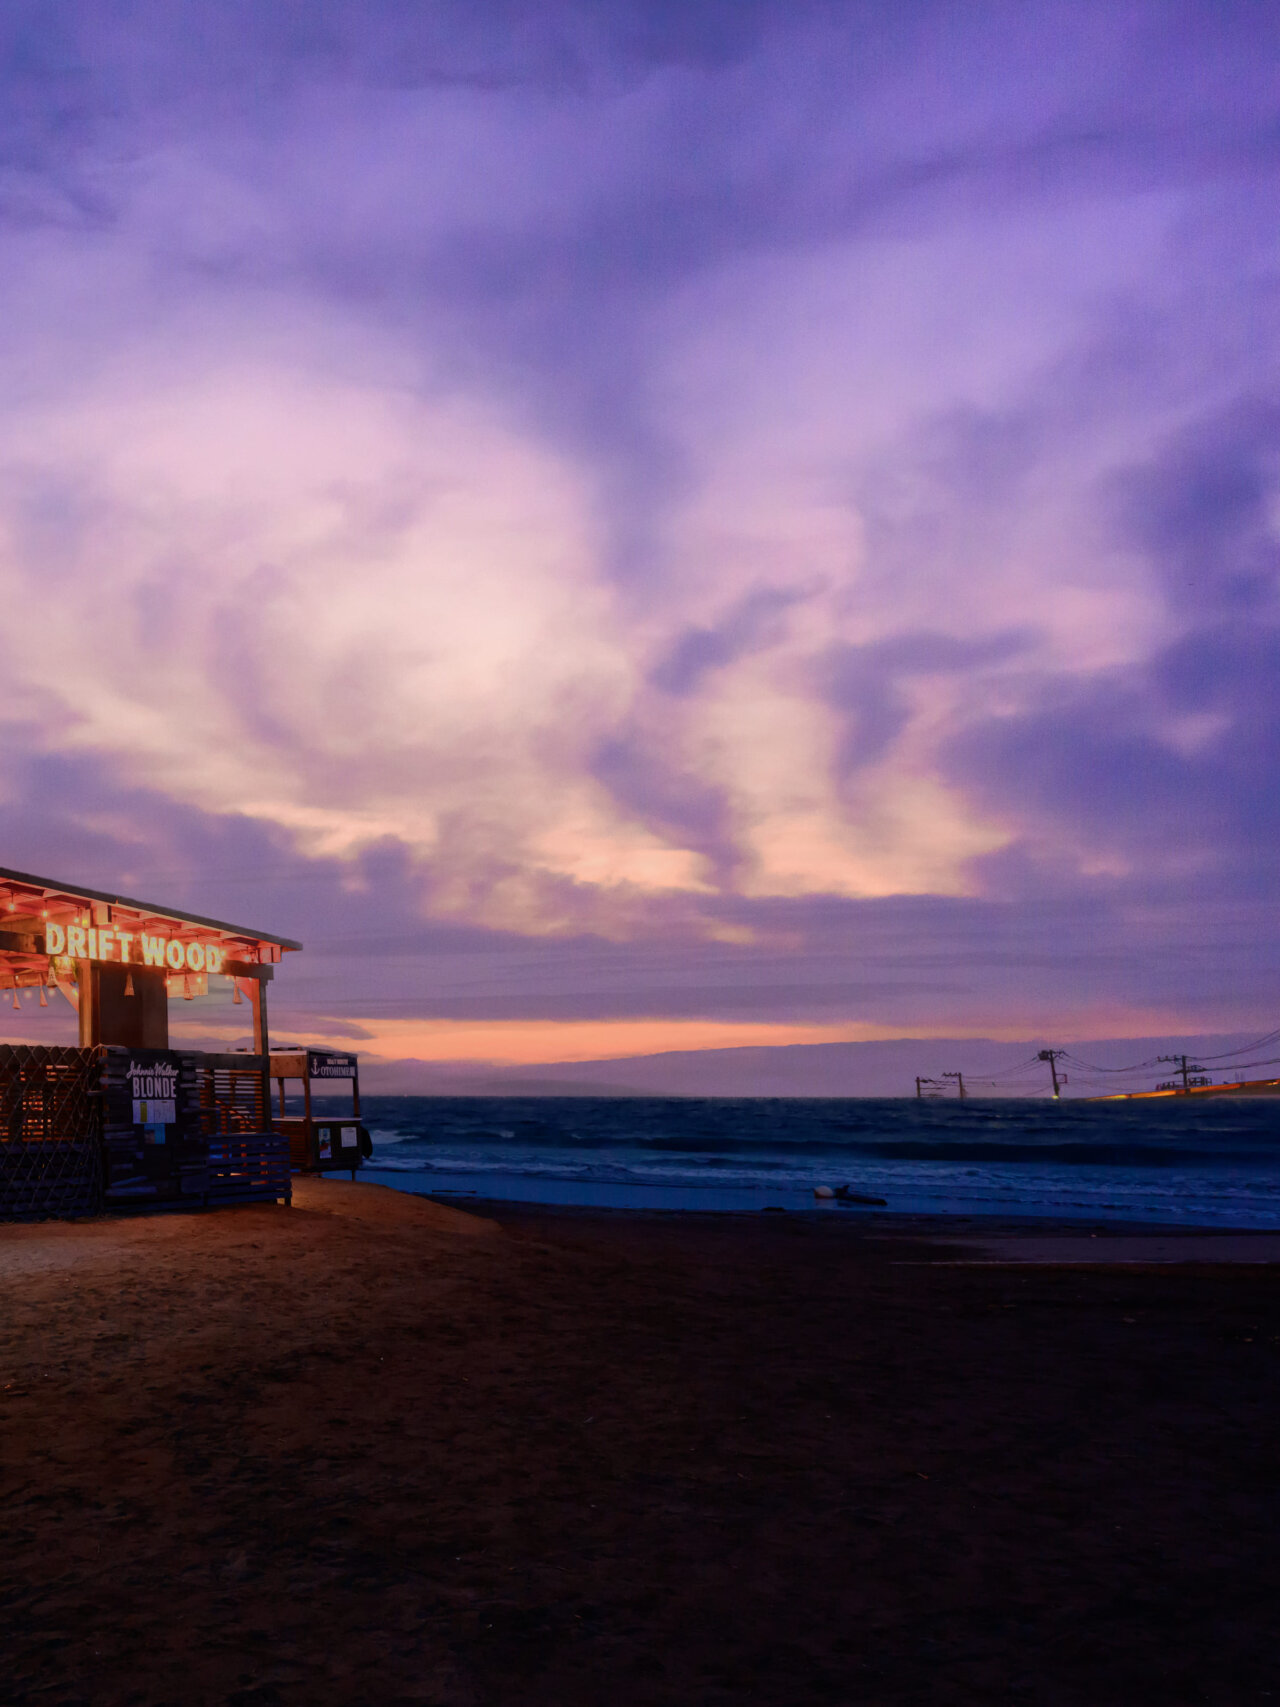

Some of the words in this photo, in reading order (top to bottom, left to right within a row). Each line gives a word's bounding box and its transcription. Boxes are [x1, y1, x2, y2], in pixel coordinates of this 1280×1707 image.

[45, 922, 134, 963] DRIFT
[141, 933, 221, 973] WOOD
[126, 1060, 155, 1079] Johnnie
[154, 1061, 180, 1077] Walker
[132, 1076, 177, 1098] BLONDE
